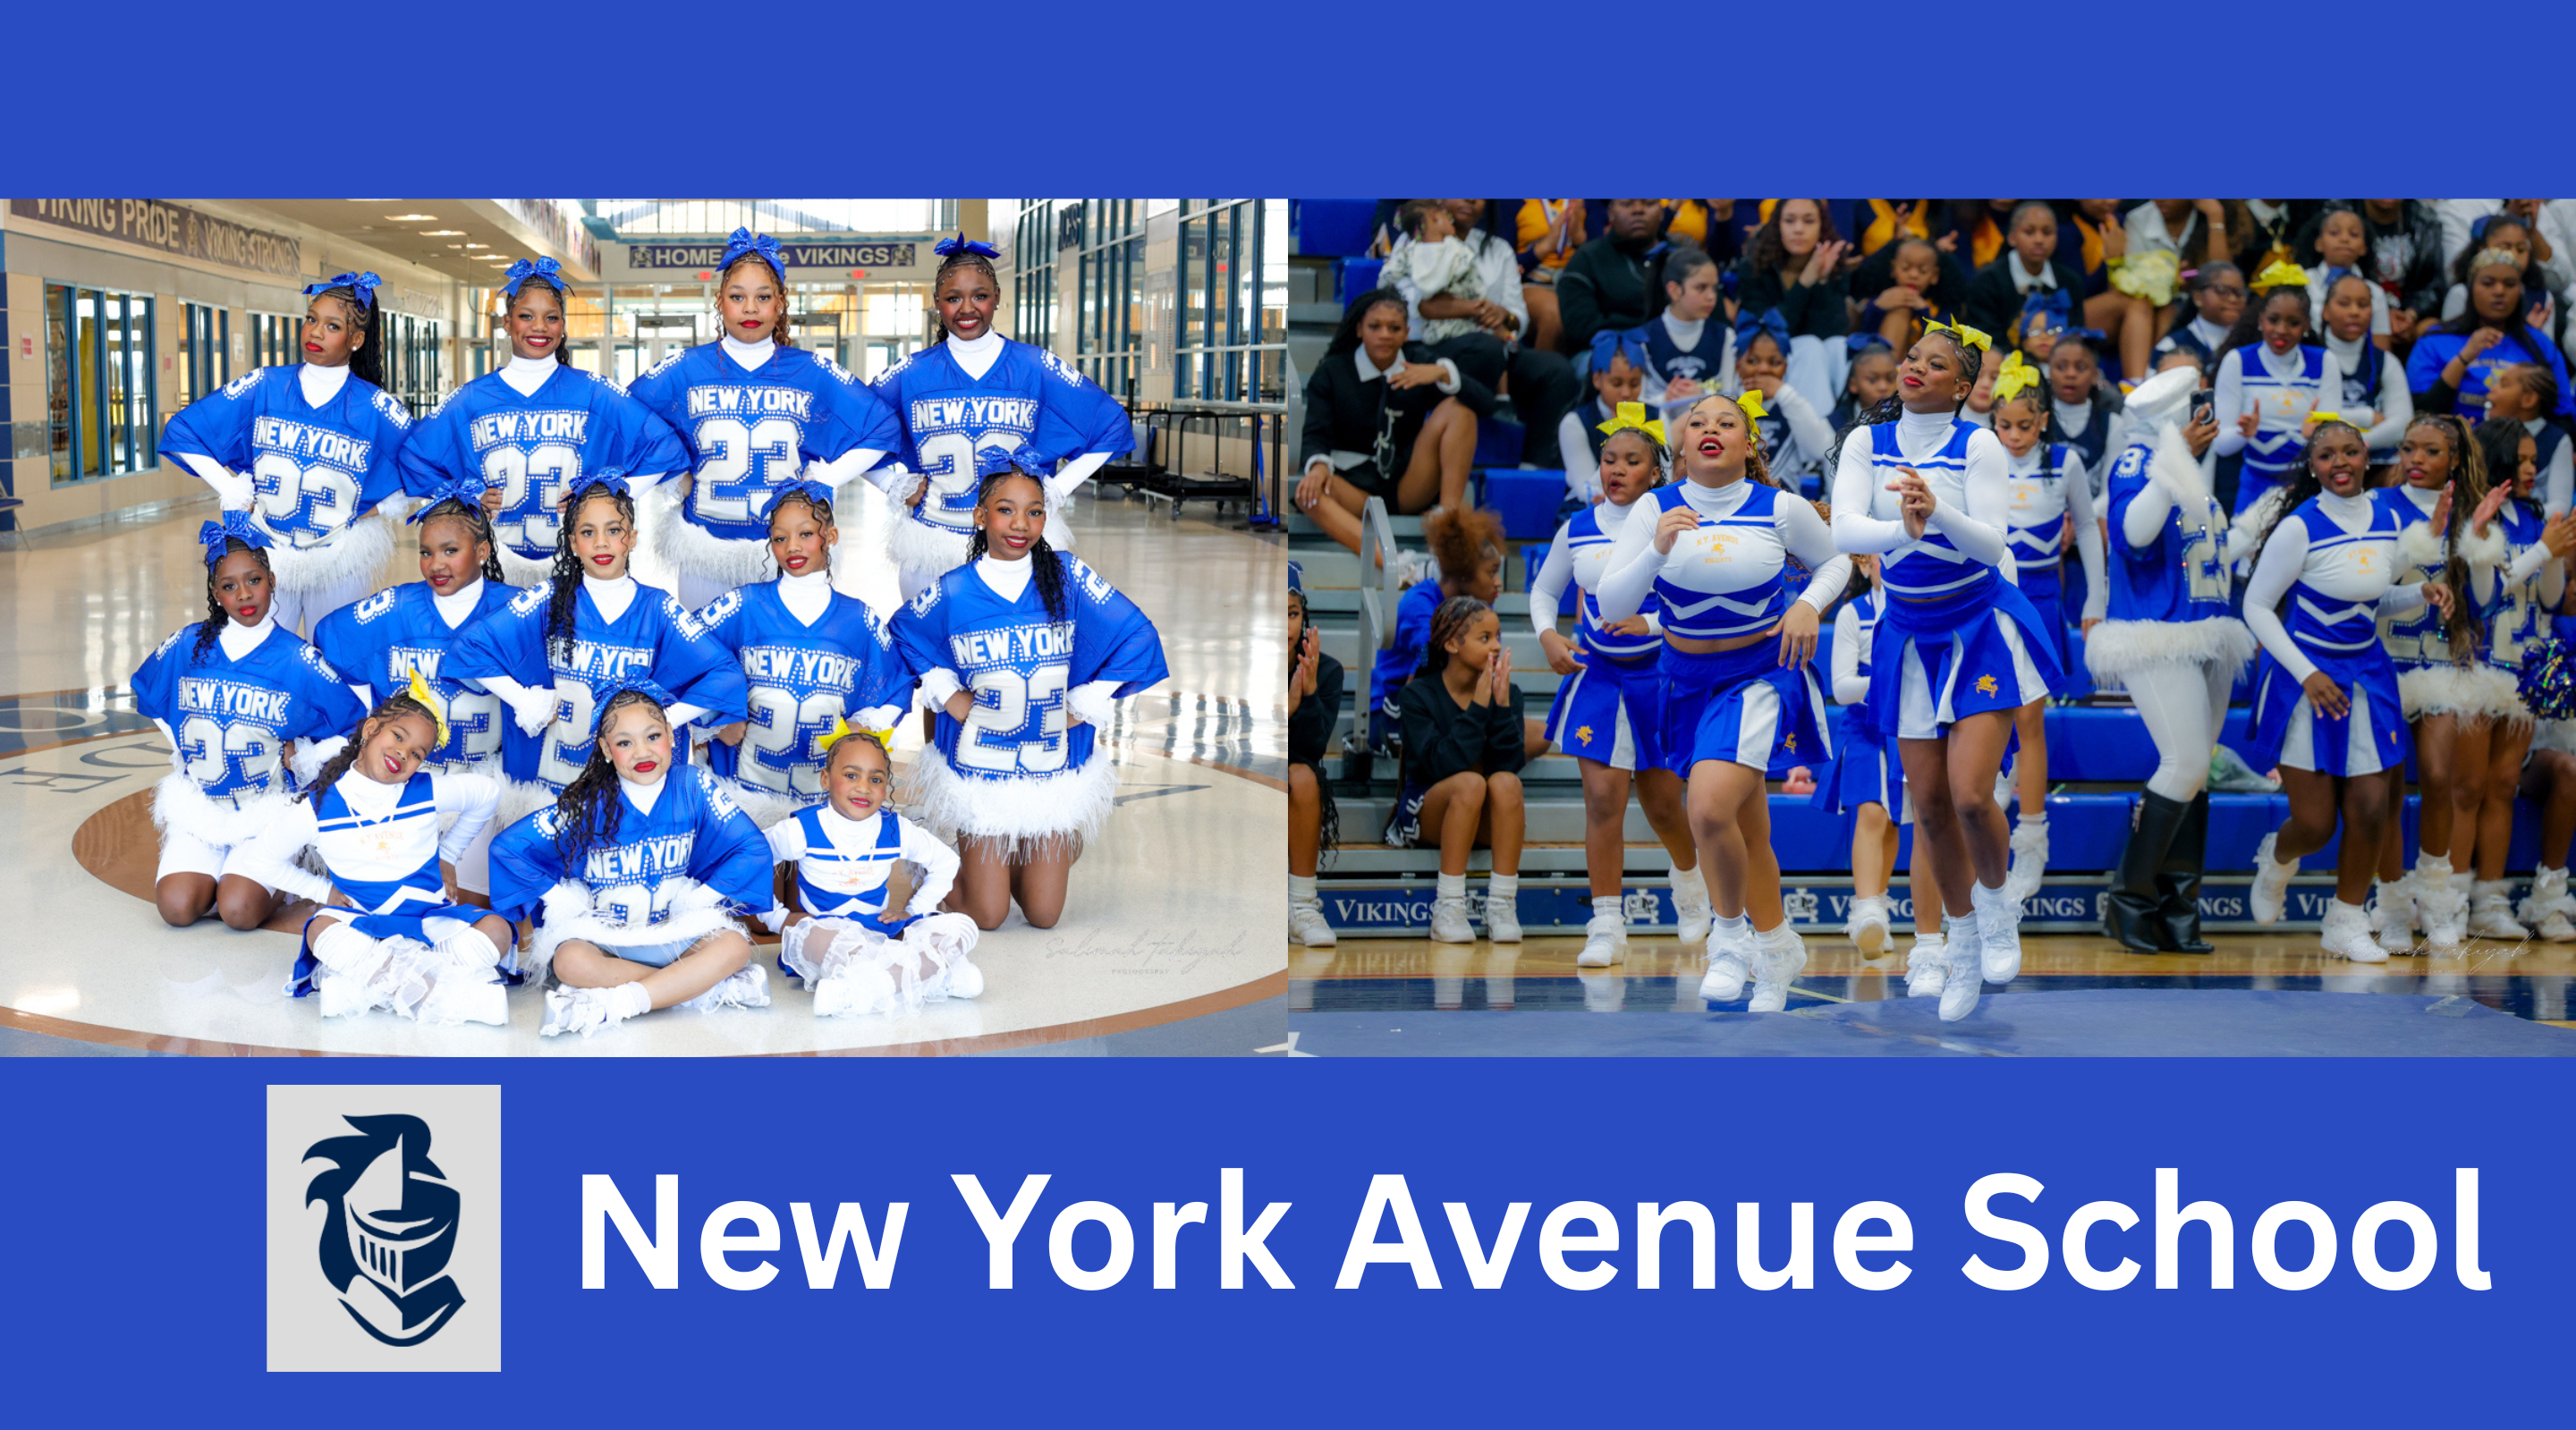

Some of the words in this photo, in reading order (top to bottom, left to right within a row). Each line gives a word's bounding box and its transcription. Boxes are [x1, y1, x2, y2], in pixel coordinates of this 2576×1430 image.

[123, 199, 179, 248] PRIDE
[204, 219, 246, 266] VIKING
[248, 233, 292, 268] STRONG
[656, 249, 722, 265] HOME
[795, 247, 889, 265] VIKINGS
[690, 388, 741, 414] NEW
[749, 388, 810, 418] YORK
[916, 401, 965, 428] NEW
[970, 400, 1034, 428] YORK
[257, 419, 301, 450] NEW
[305, 428, 367, 470] YORK
[473, 414, 518, 447] NEW
[524, 412, 589, 440] YORK
[694, 419, 801, 521] 23
[2117, 447, 2147, 476] 3
[252, 453, 360, 548] 23
[484, 445, 580, 547] 23
[1711, 534, 1740, 545] AVENUE
[1074, 557, 1111, 600] 2
[1705, 556, 1733, 564] KNIGHTS
[359, 588, 391, 619] 3
[667, 598, 703, 637] 2
[601, 647, 654, 678] YOR
[953, 630, 1009, 664] NEW
[1016, 624, 1075, 657] YORK
[391, 650, 440, 680] NEW
[744, 649, 795, 679] NEW
[801, 654, 856, 689] YORK
[182, 681, 216, 710] NEW
[221, 685, 287, 722] YORK
[955, 664, 1070, 773] 23
[429, 689, 503, 774] 3
[537, 678, 597, 792] 2
[737, 685, 845, 795] 23
[182, 717, 284, 807] 23
[586, 844, 643, 878] NEW
[1335, 899, 1435, 922] VIKINGS
[2021, 897, 2086, 918] KINGS
